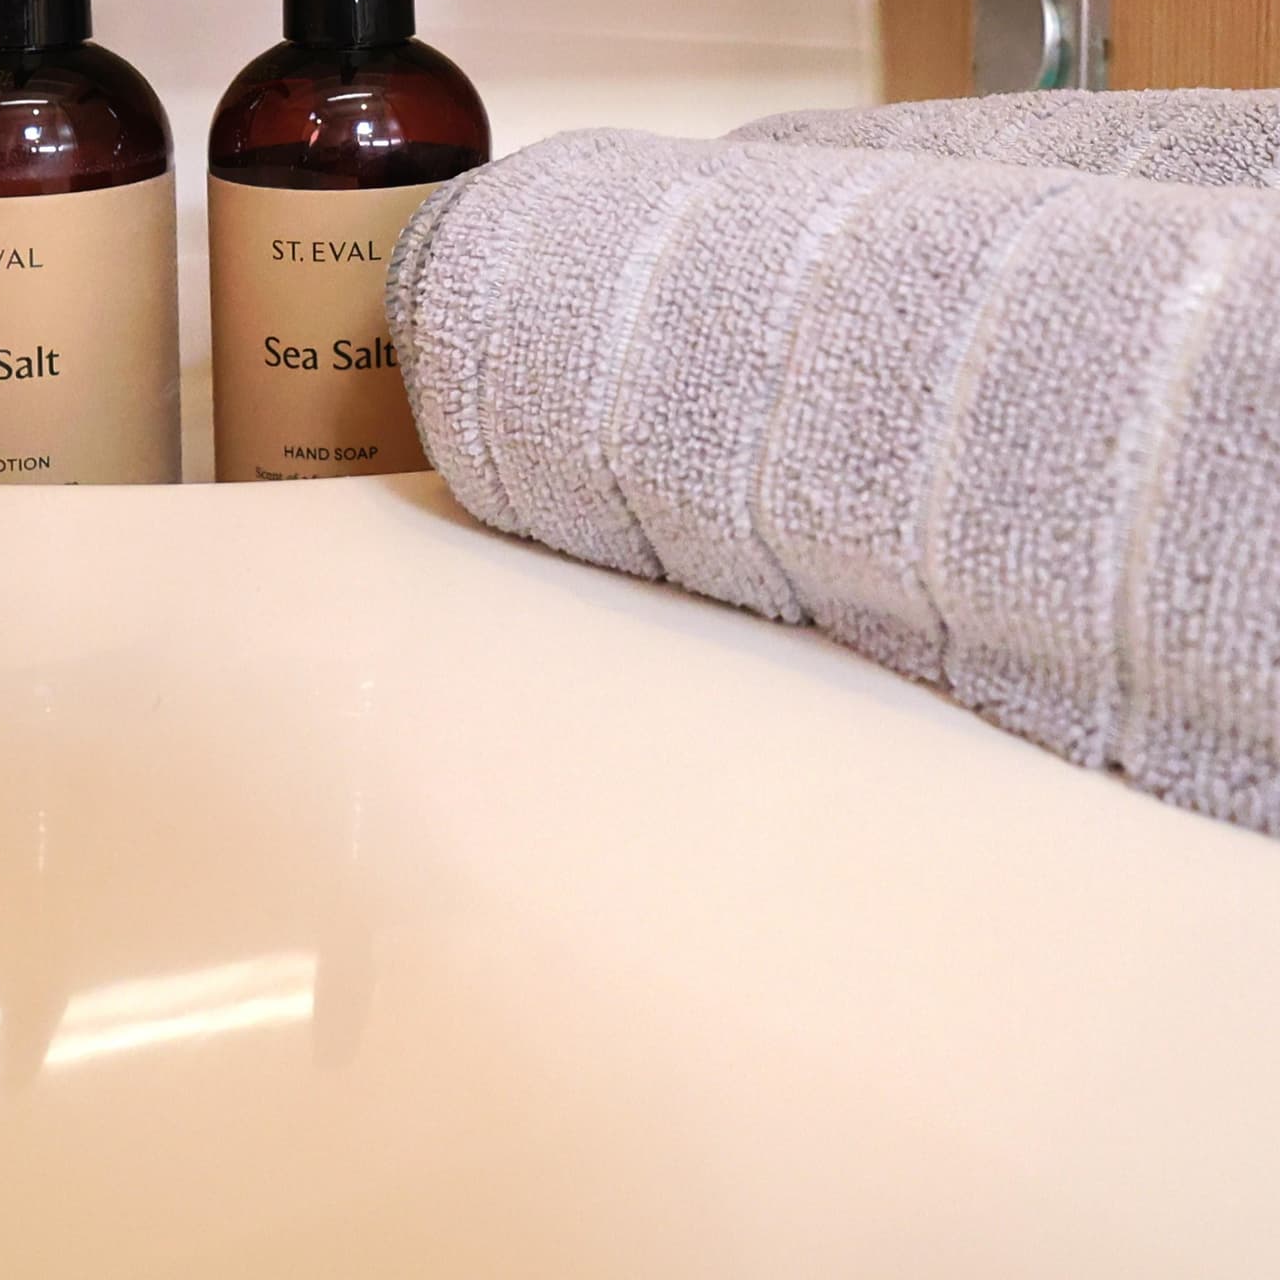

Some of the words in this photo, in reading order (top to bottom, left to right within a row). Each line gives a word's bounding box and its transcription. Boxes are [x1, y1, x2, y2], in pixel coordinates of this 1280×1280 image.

[312, 239, 382, 263] EVAL
[264, 336, 318, 371] Sea
[332, 336, 398, 371] Salt
[284, 445, 330, 461] HAND
[334, 445, 379, 461] SOAP
